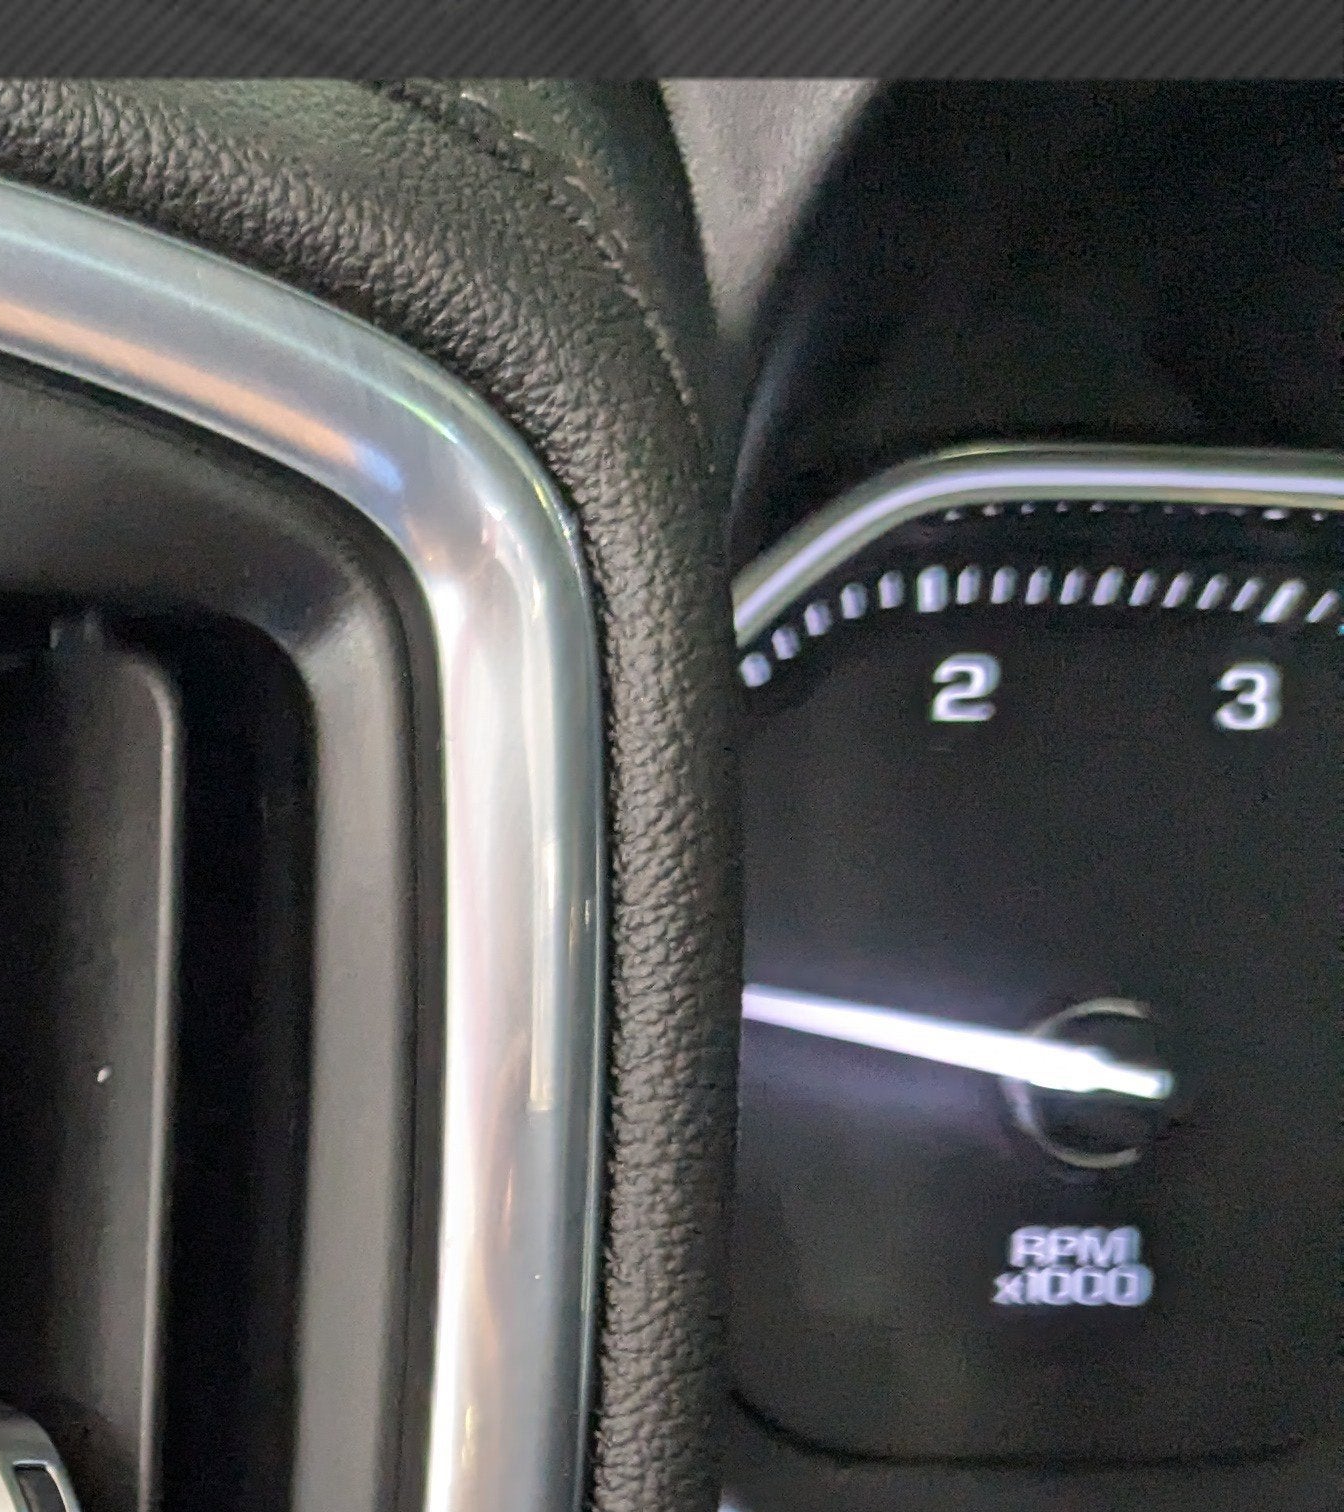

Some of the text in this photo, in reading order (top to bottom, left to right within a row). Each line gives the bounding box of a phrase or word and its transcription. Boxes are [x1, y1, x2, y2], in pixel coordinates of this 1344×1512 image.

[931, 652, 1001, 722] 2
[1215, 661, 1283, 731] 3
[1010, 1225, 1143, 1268] RPM
